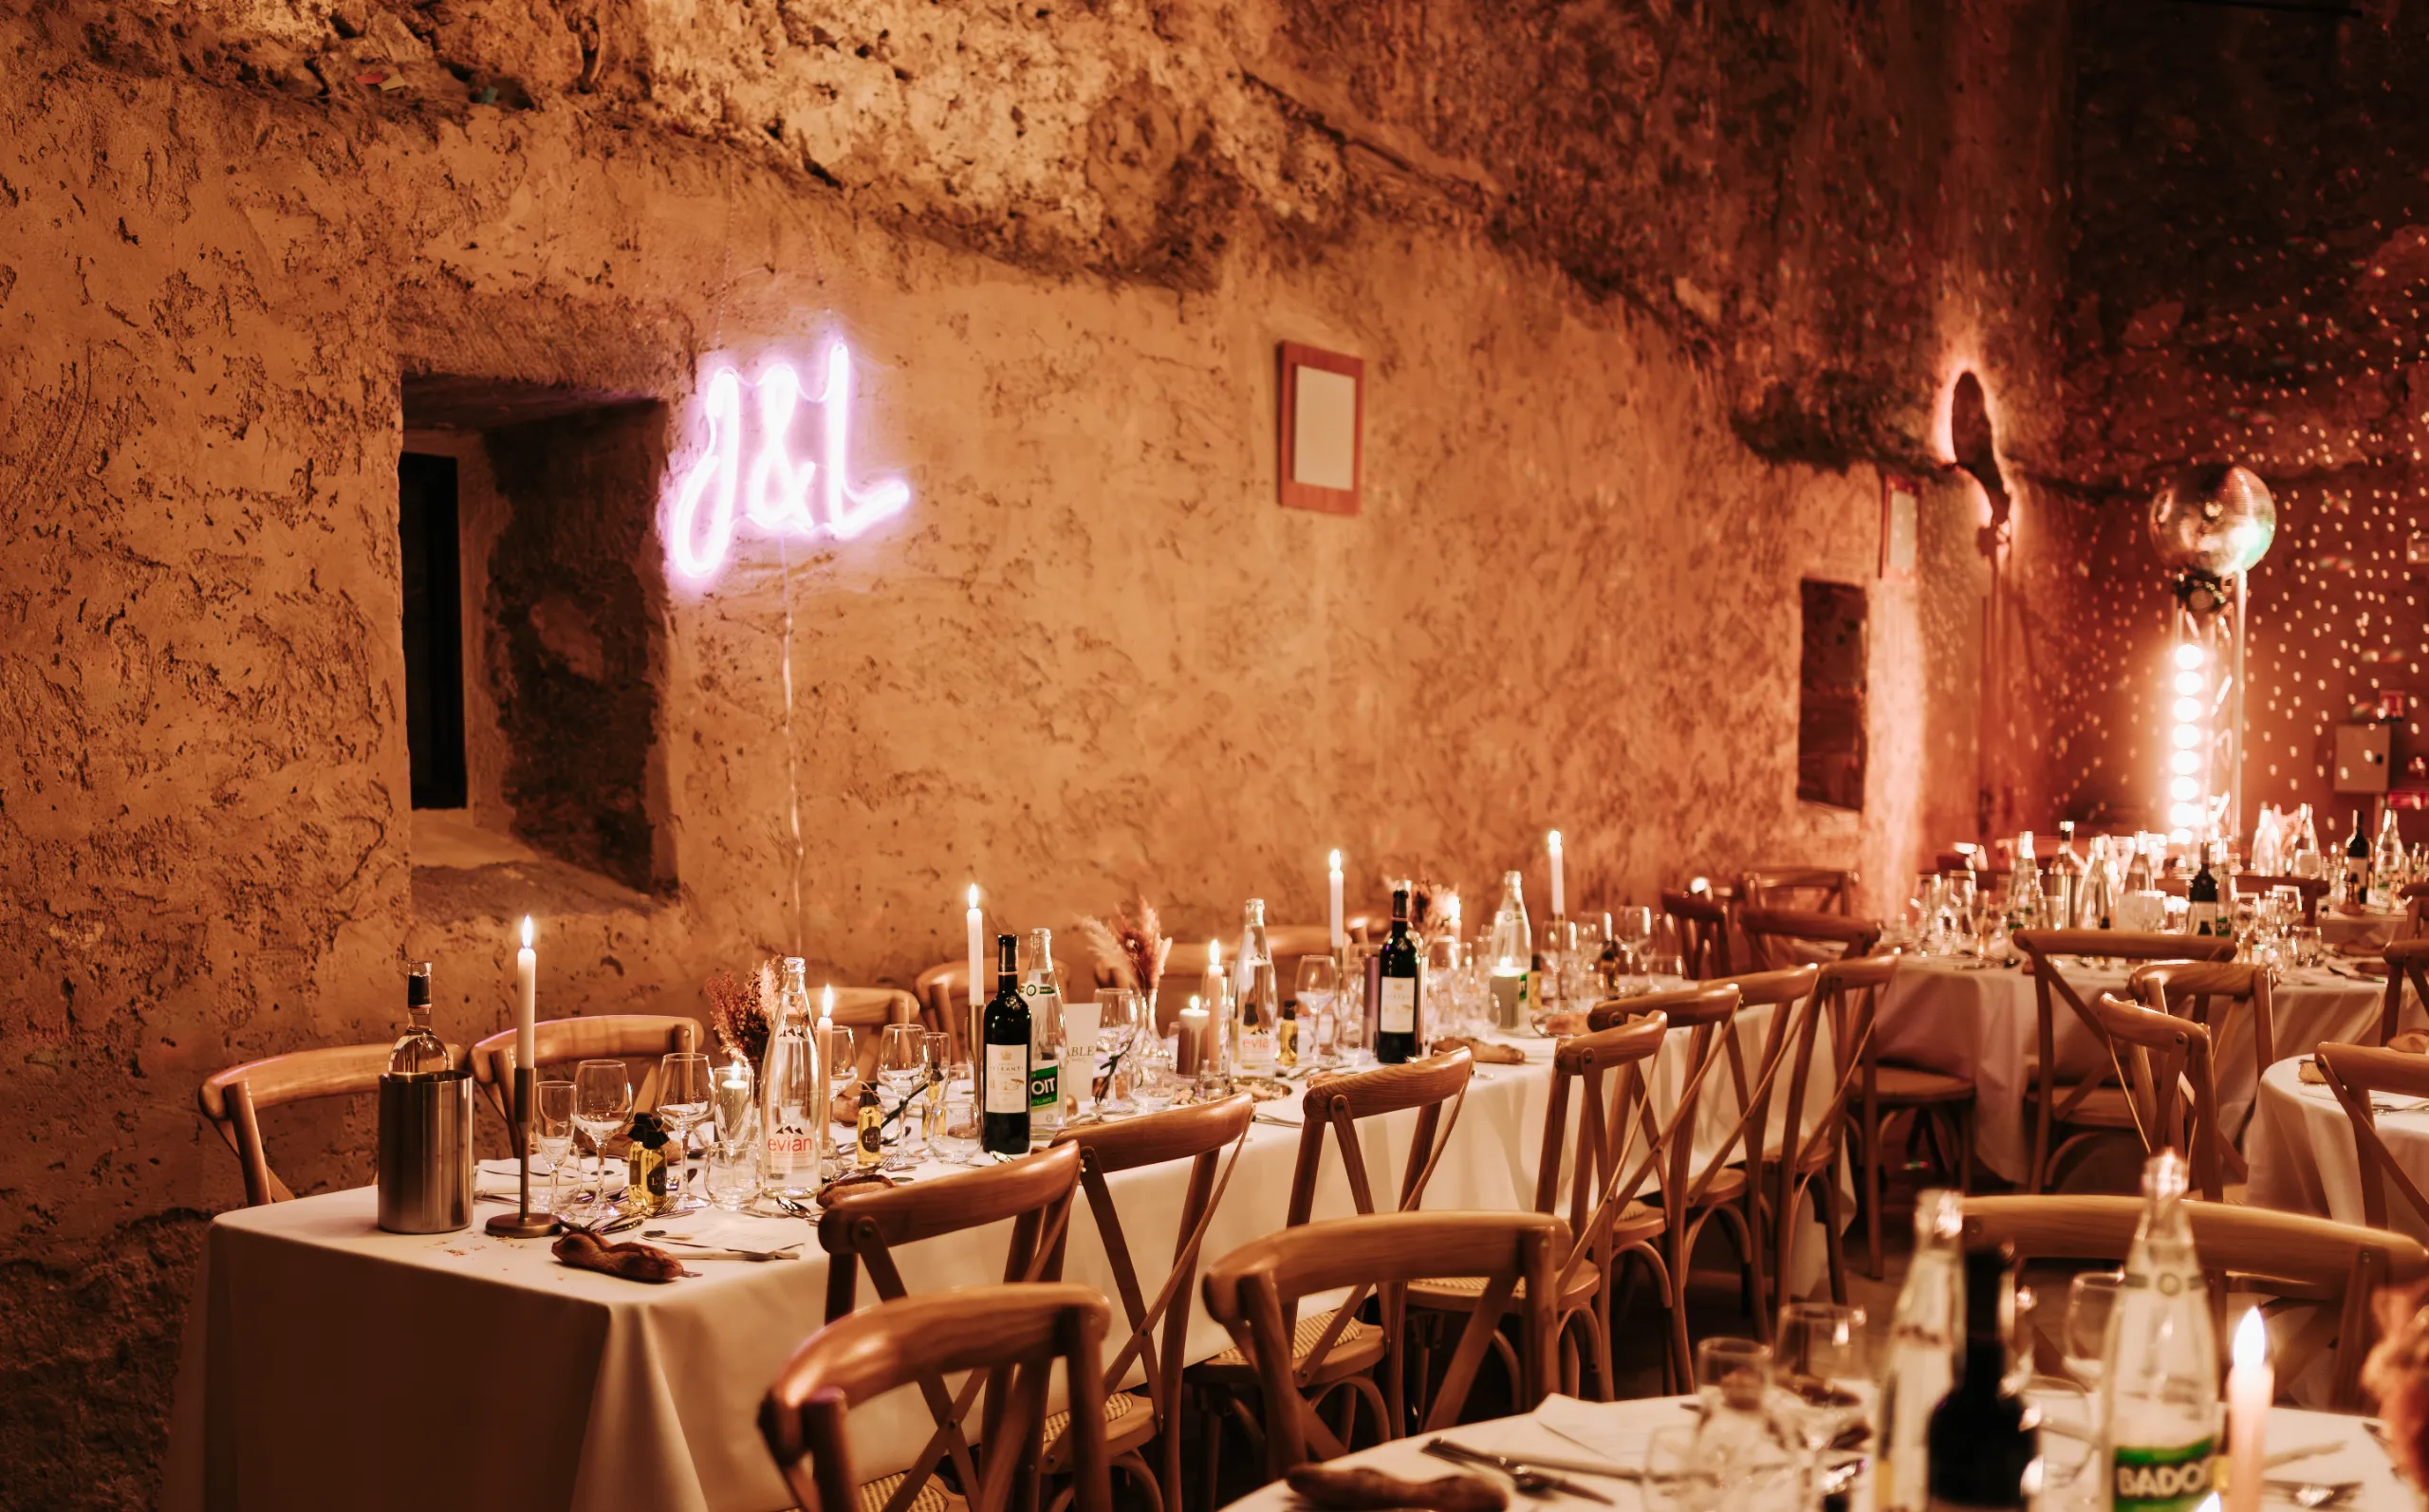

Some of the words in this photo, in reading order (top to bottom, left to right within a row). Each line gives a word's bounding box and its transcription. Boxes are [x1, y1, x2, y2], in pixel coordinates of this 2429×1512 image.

[1065, 1045, 1095, 1057] ABLE
[1242, 1039, 1272, 1049] evia
[1031, 1078, 1055, 1096] OIT
[768, 1135, 813, 1152] evian
[2117, 1462, 2207, 1498] BADO
